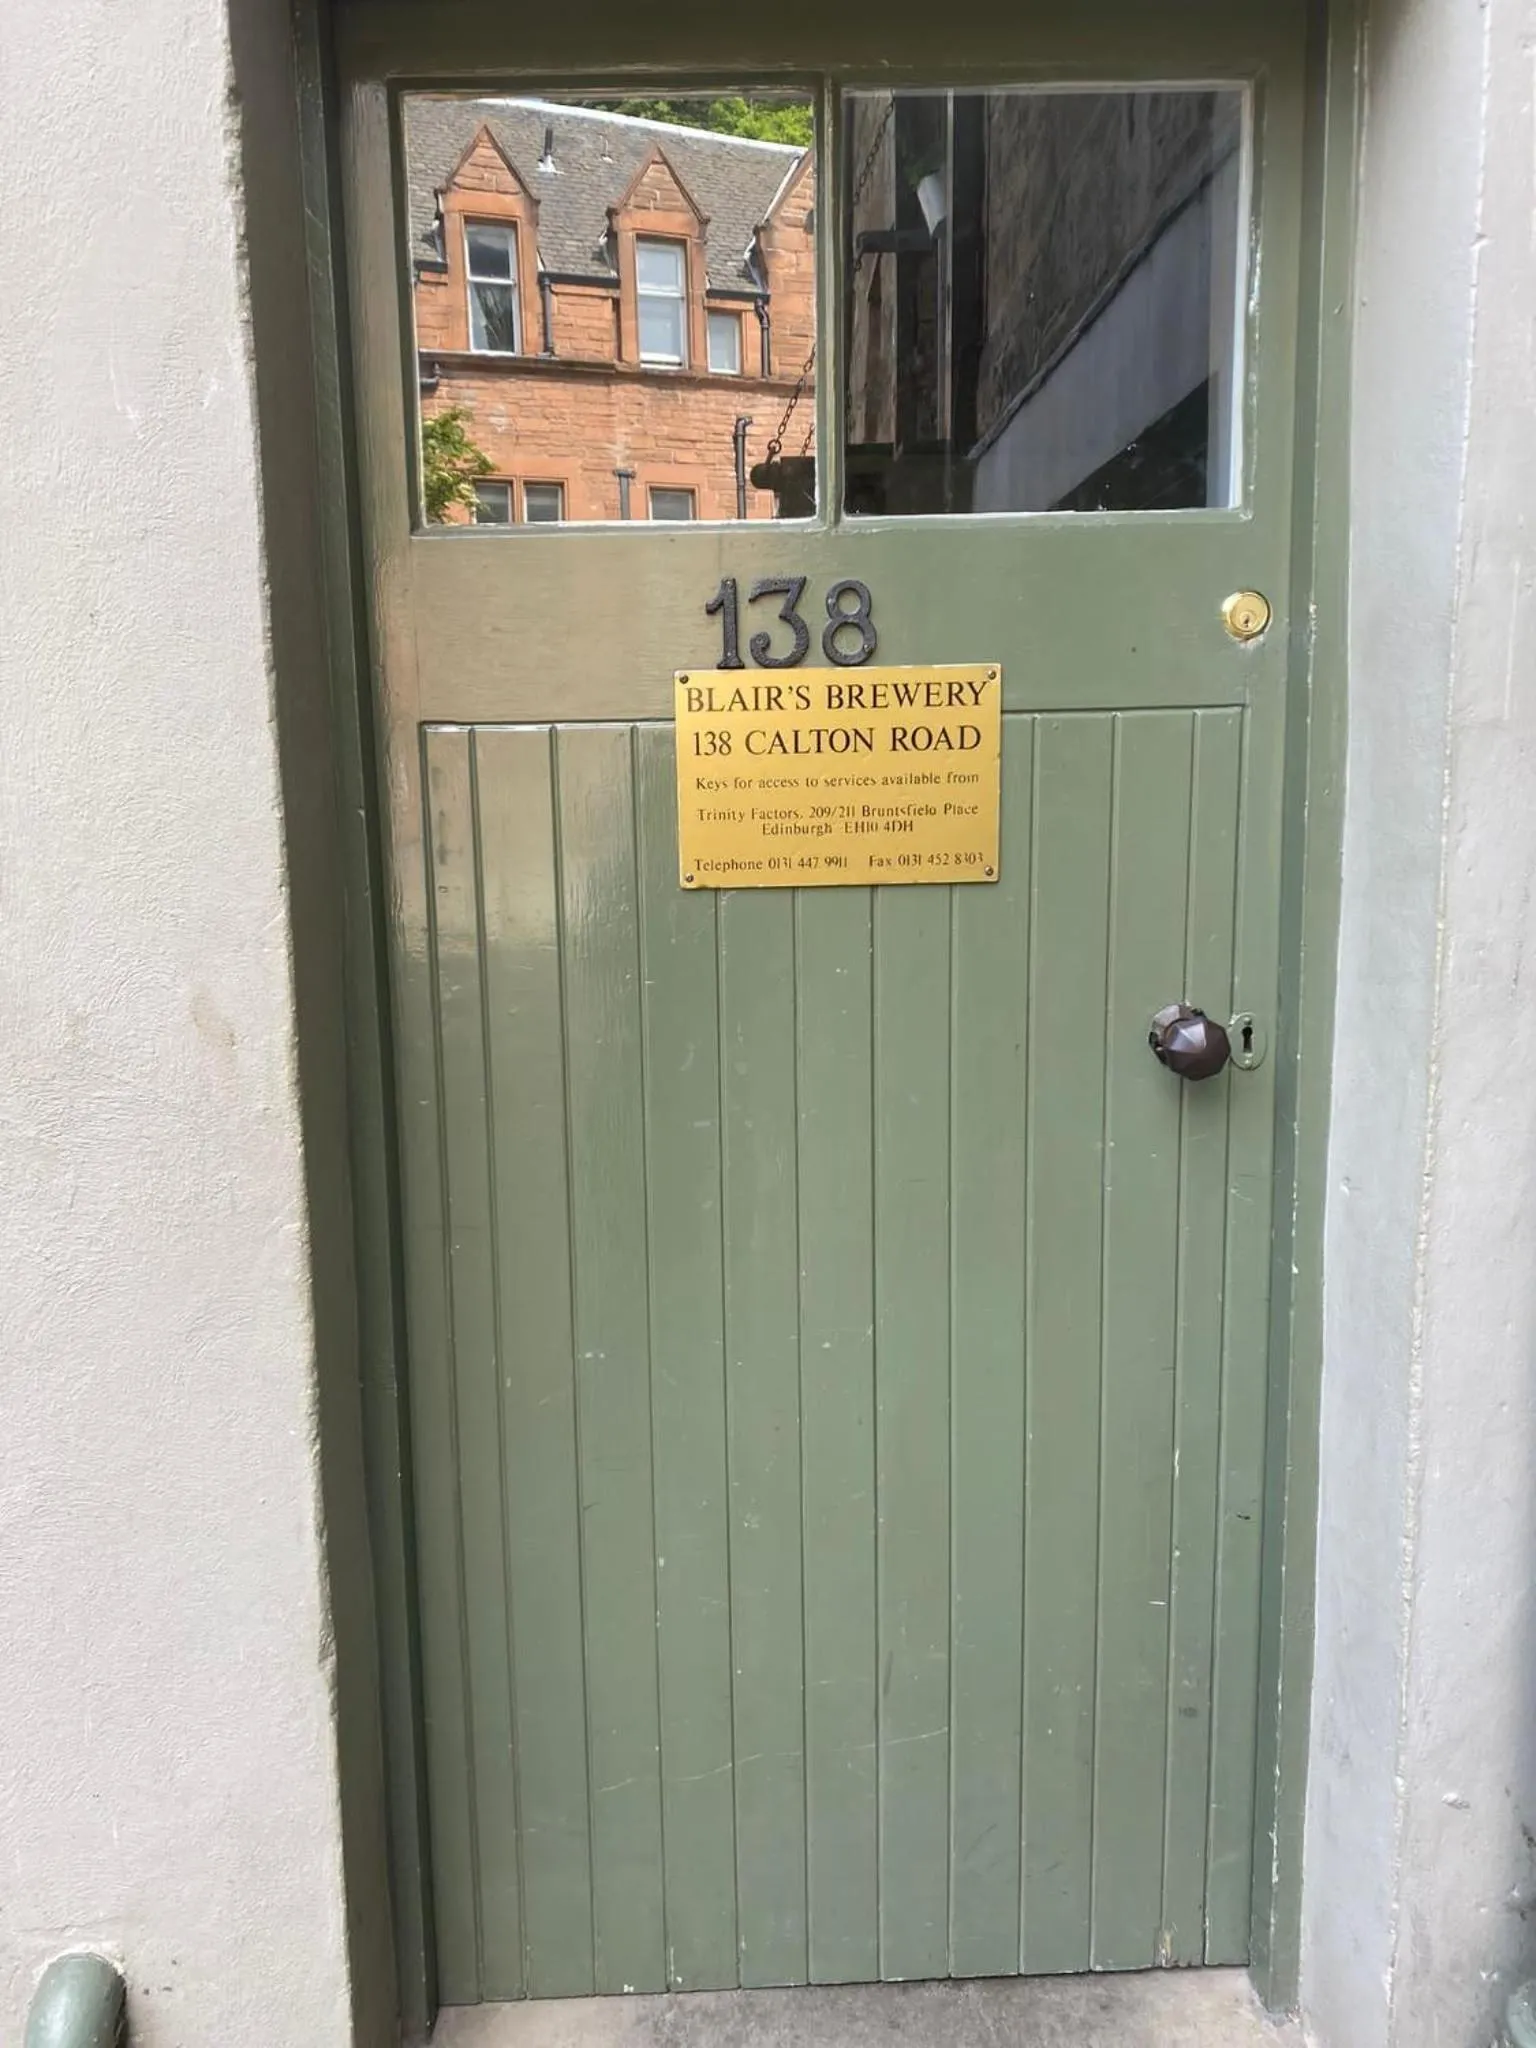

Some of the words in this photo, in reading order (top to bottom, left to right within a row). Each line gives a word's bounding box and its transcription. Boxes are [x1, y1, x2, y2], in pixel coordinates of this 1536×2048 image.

[705, 575, 877, 669] 138
[686, 684, 811, 713] BLAIR'S
[826, 681, 988, 710] BREWERY
[692, 730, 732, 756] 138
[744, 726, 875, 755] CALTON
[891, 724, 982, 752] ROAD
[696, 777, 728, 791] Keys
[734, 777, 752, 789] for
[758, 778, 799, 788] access
[805, 777, 818, 788] to
[824, 774, 876, 787] services
[881, 772, 941, 785] available
[946, 771, 979, 784] from
[698, 808, 745, 822] Trinity
[808, 805, 856, 819] 209/211
[862, 803, 937, 817] Bruntsfield
[943, 802, 979, 815] Place
[762, 822, 833, 836] Edinburgh
[844, 821, 879, 834] EH10
[883, 820, 914, 833] 4DH
[694, 857, 763, 873] Telephone
[768, 856, 792, 870] 0131
[797, 856, 820, 870] 447
[824, 855, 848, 869] 9911
[869, 855, 892, 867] Fax
[897, 854, 922, 867] 0131
[927, 853, 950, 866] 452
